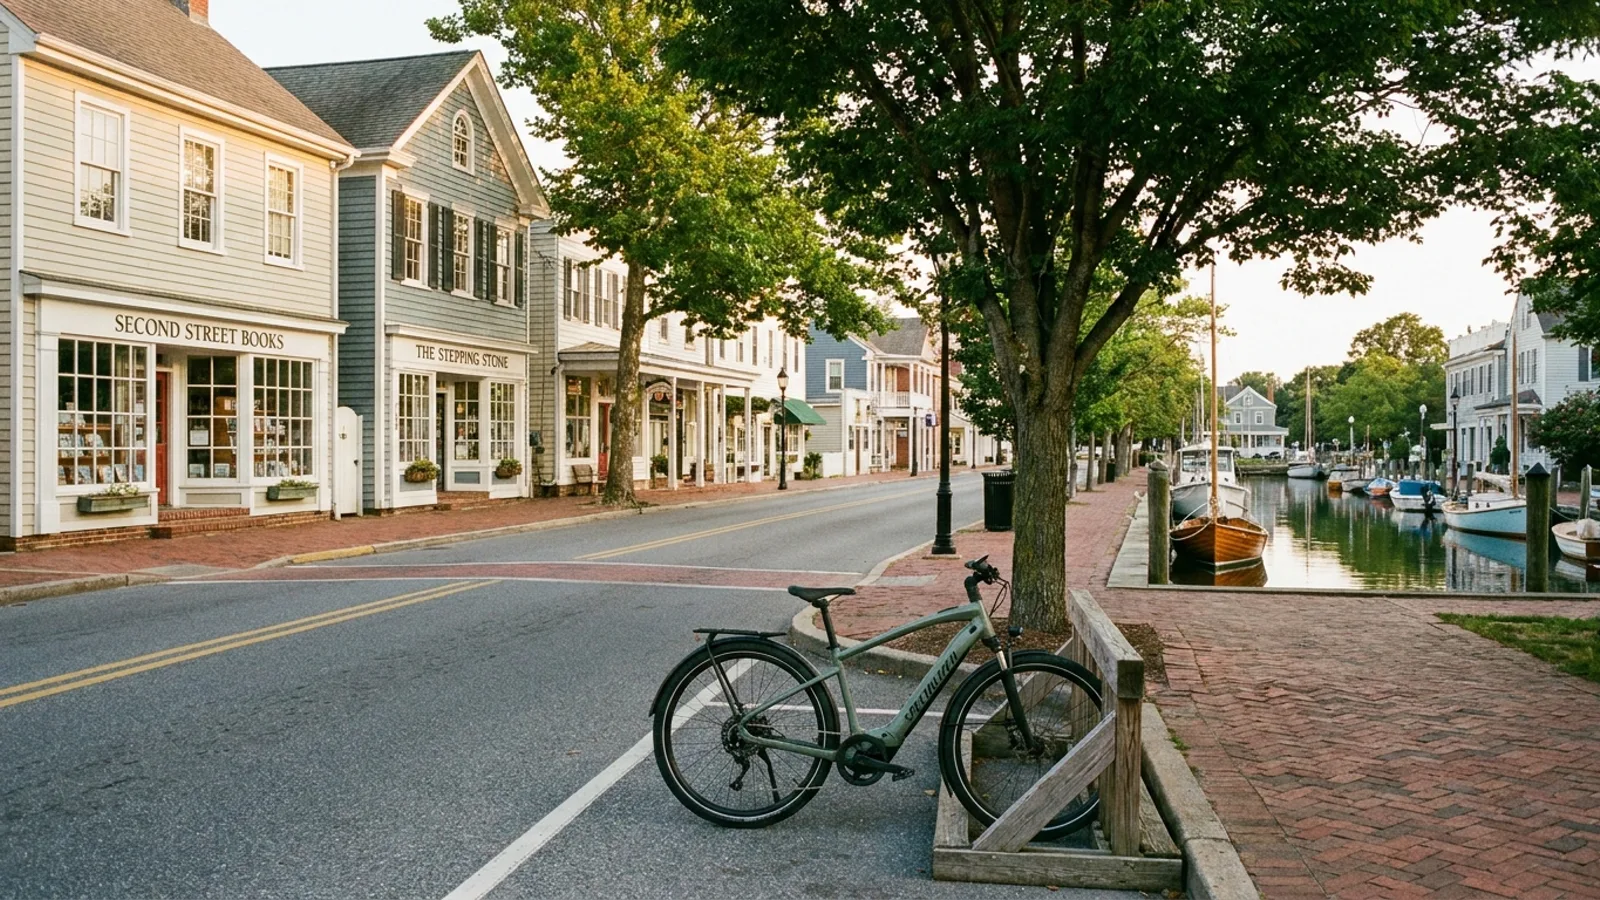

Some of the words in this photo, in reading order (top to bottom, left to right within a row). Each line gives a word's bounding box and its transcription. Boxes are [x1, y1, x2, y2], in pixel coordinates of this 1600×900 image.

[115, 314, 180, 338] SECOND
[185, 323, 237, 345] STREET
[241, 330, 284, 349] BOOKS
[416, 345, 435, 360] THE
[438, 348, 479, 366] STEPPING
[483, 354, 508, 368] STONE
